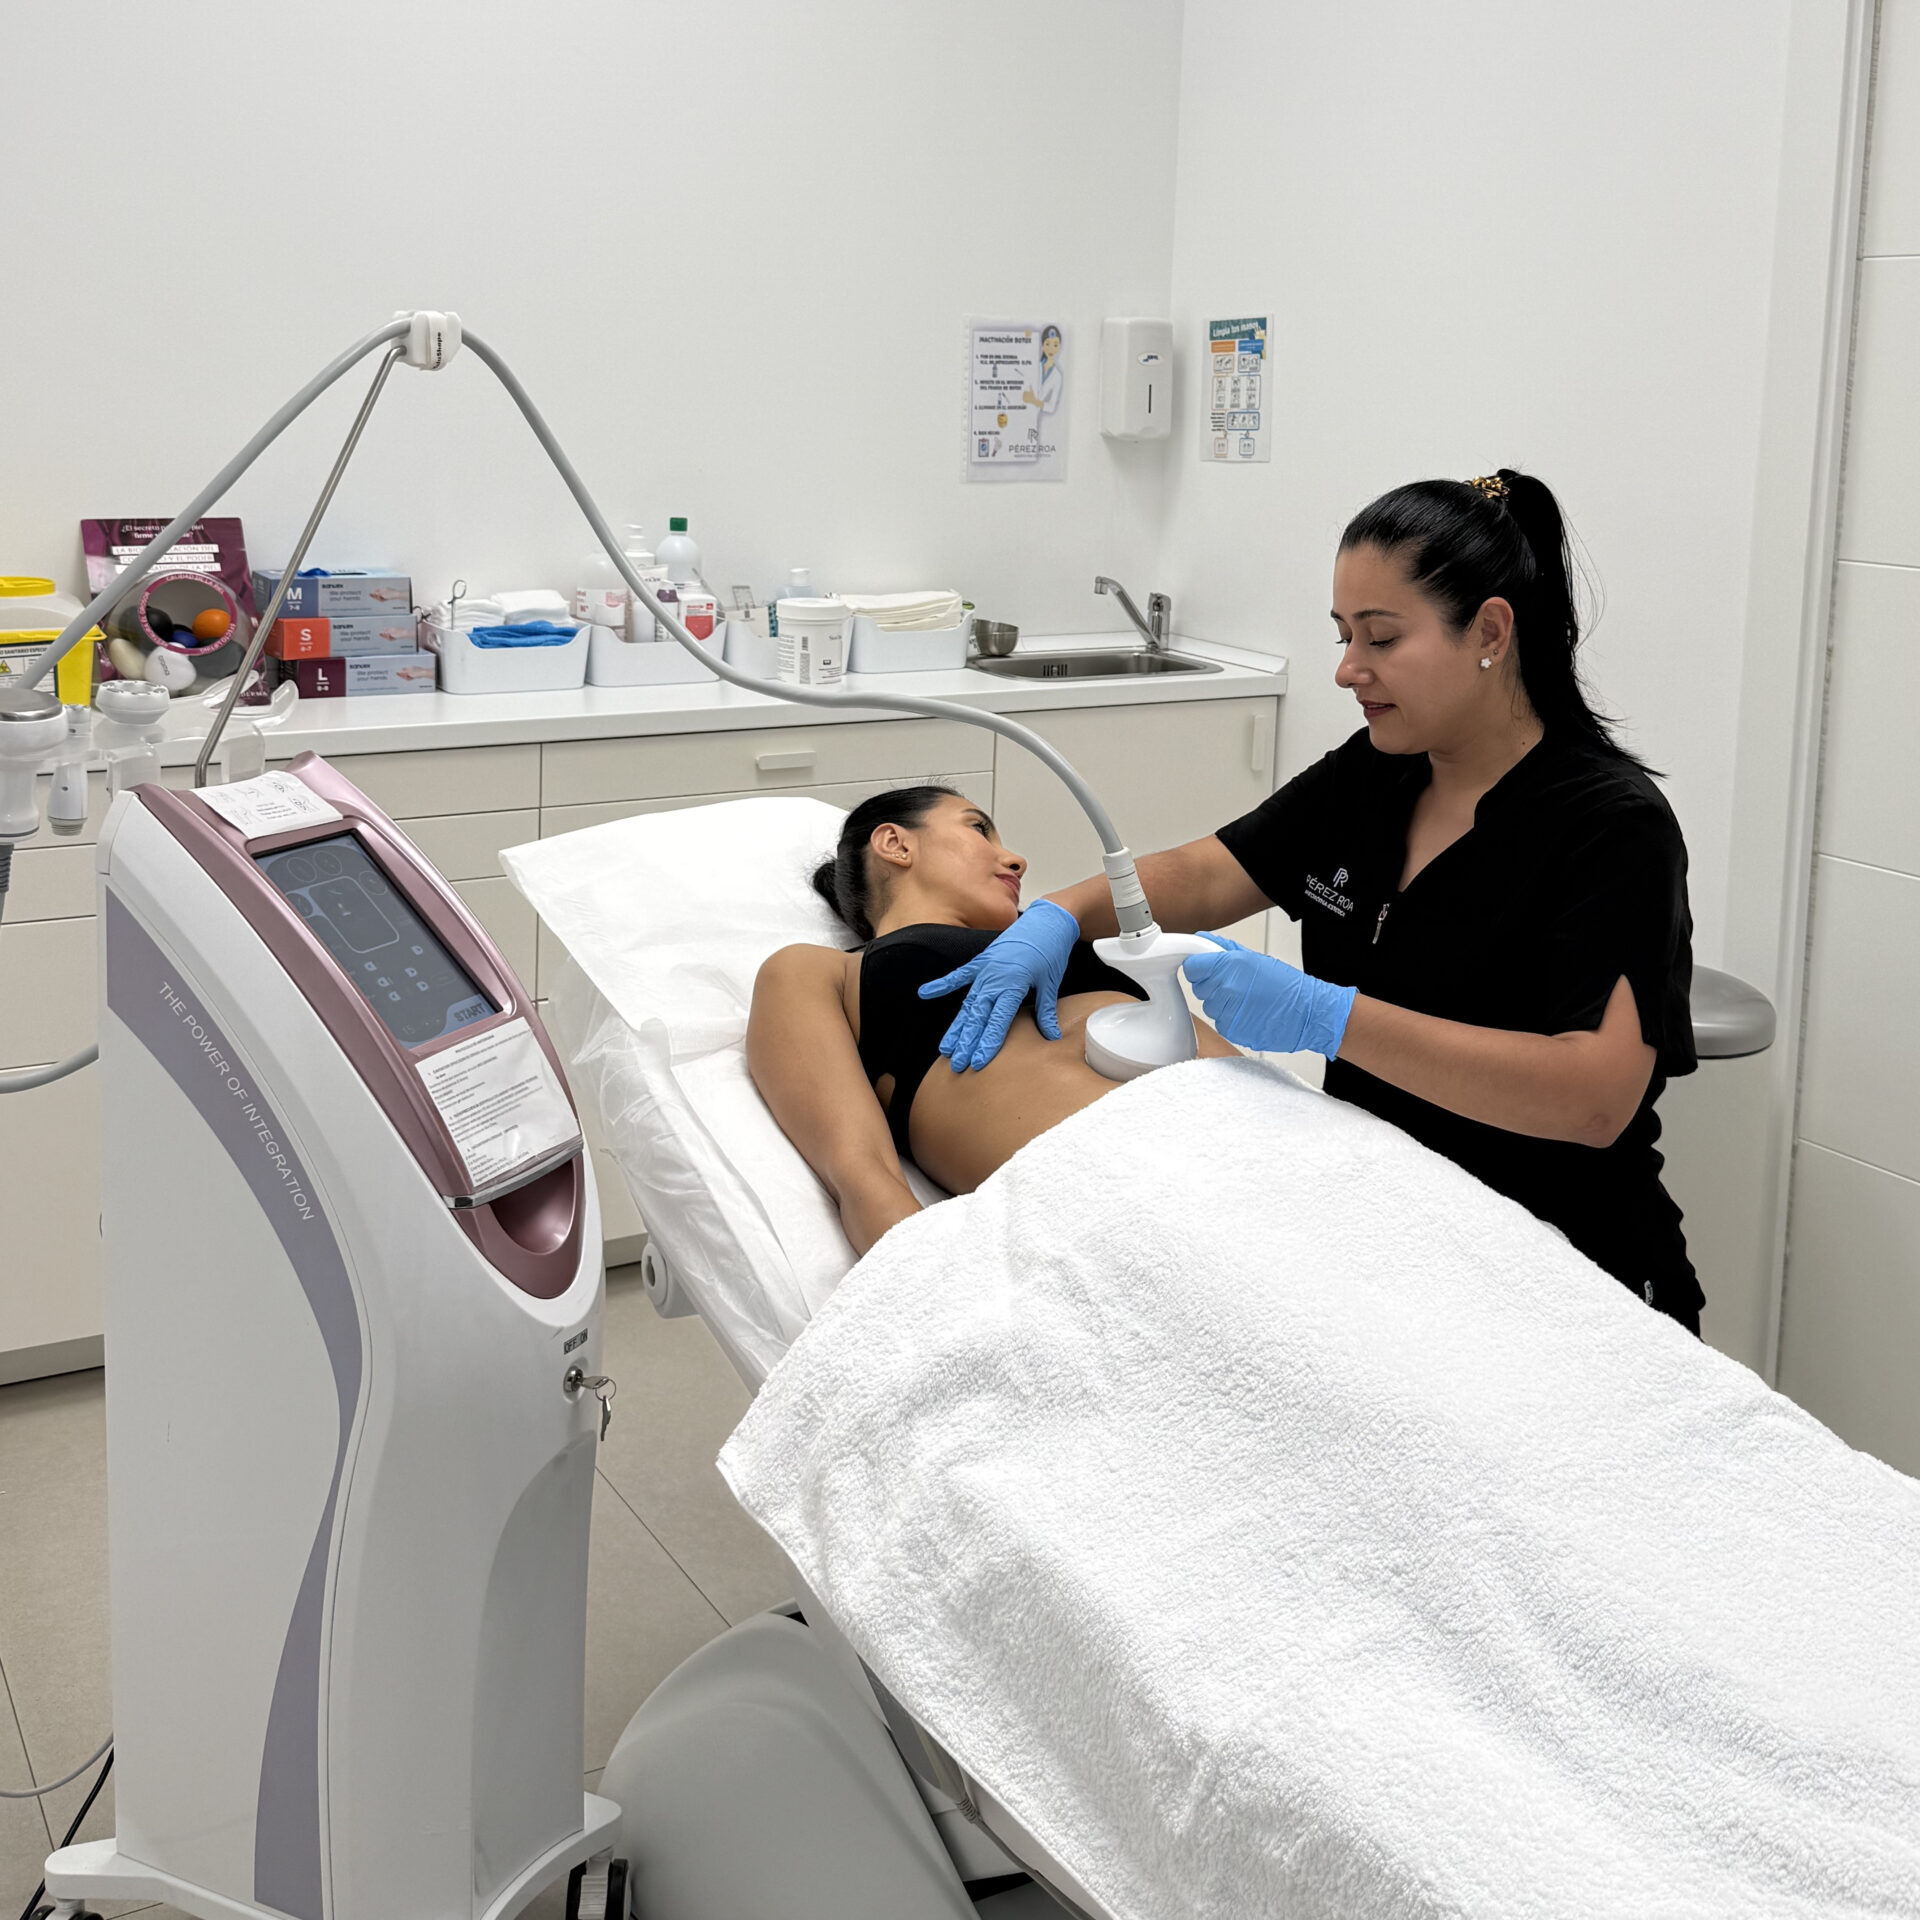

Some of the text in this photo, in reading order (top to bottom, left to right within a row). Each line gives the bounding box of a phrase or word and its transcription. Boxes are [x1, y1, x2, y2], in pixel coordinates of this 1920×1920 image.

[1009, 444, 1056, 453] PÉREZ ROA
[287, 587, 302, 600] M
[300, 628, 312, 642] S
[318, 667, 328, 681] L
[1306, 874, 1354, 912] PÉREZ ROA
[454, 1002, 486, 1022] START
[159, 981, 315, 1221] THE POWER OF INTEGRATION
[564, 1328, 588, 1354] OFF ON
